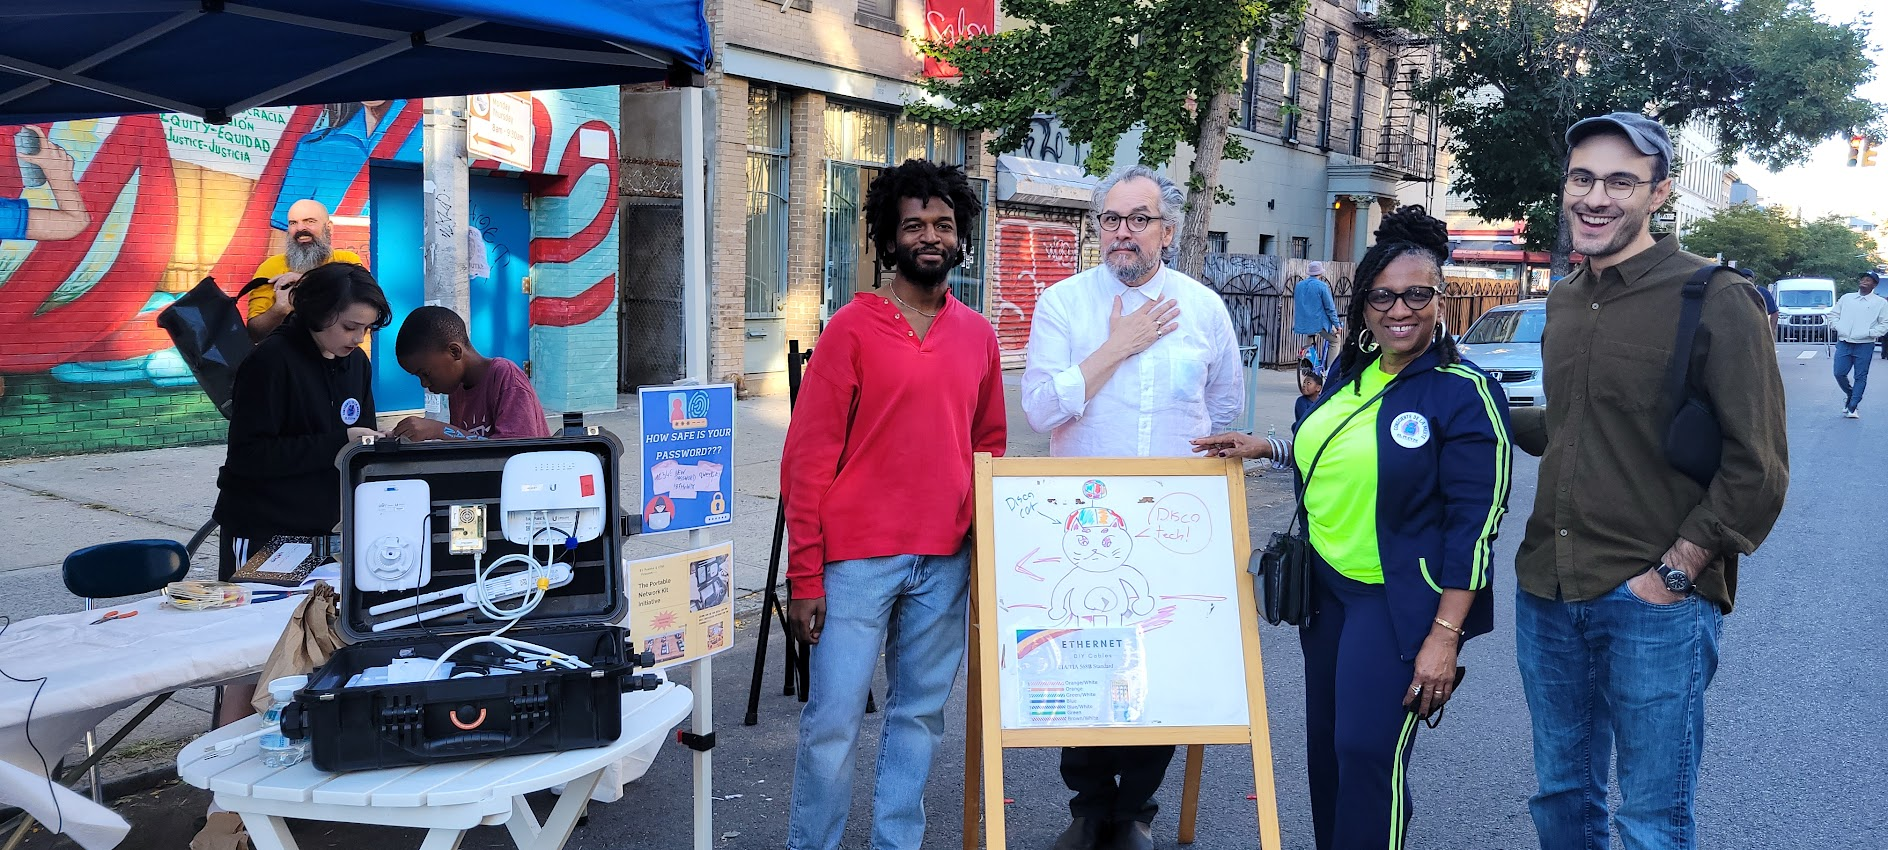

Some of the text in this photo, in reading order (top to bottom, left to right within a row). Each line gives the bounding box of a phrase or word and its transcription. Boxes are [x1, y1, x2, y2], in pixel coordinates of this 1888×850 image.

[645, 427, 732, 444] HOW SAFE IS YOUR
[655, 445, 722, 461] PASSWORD???
[649, 578, 672, 588] Portable
[638, 588, 661, 598] Network
[1061, 639, 1123, 649] ETHERNET
